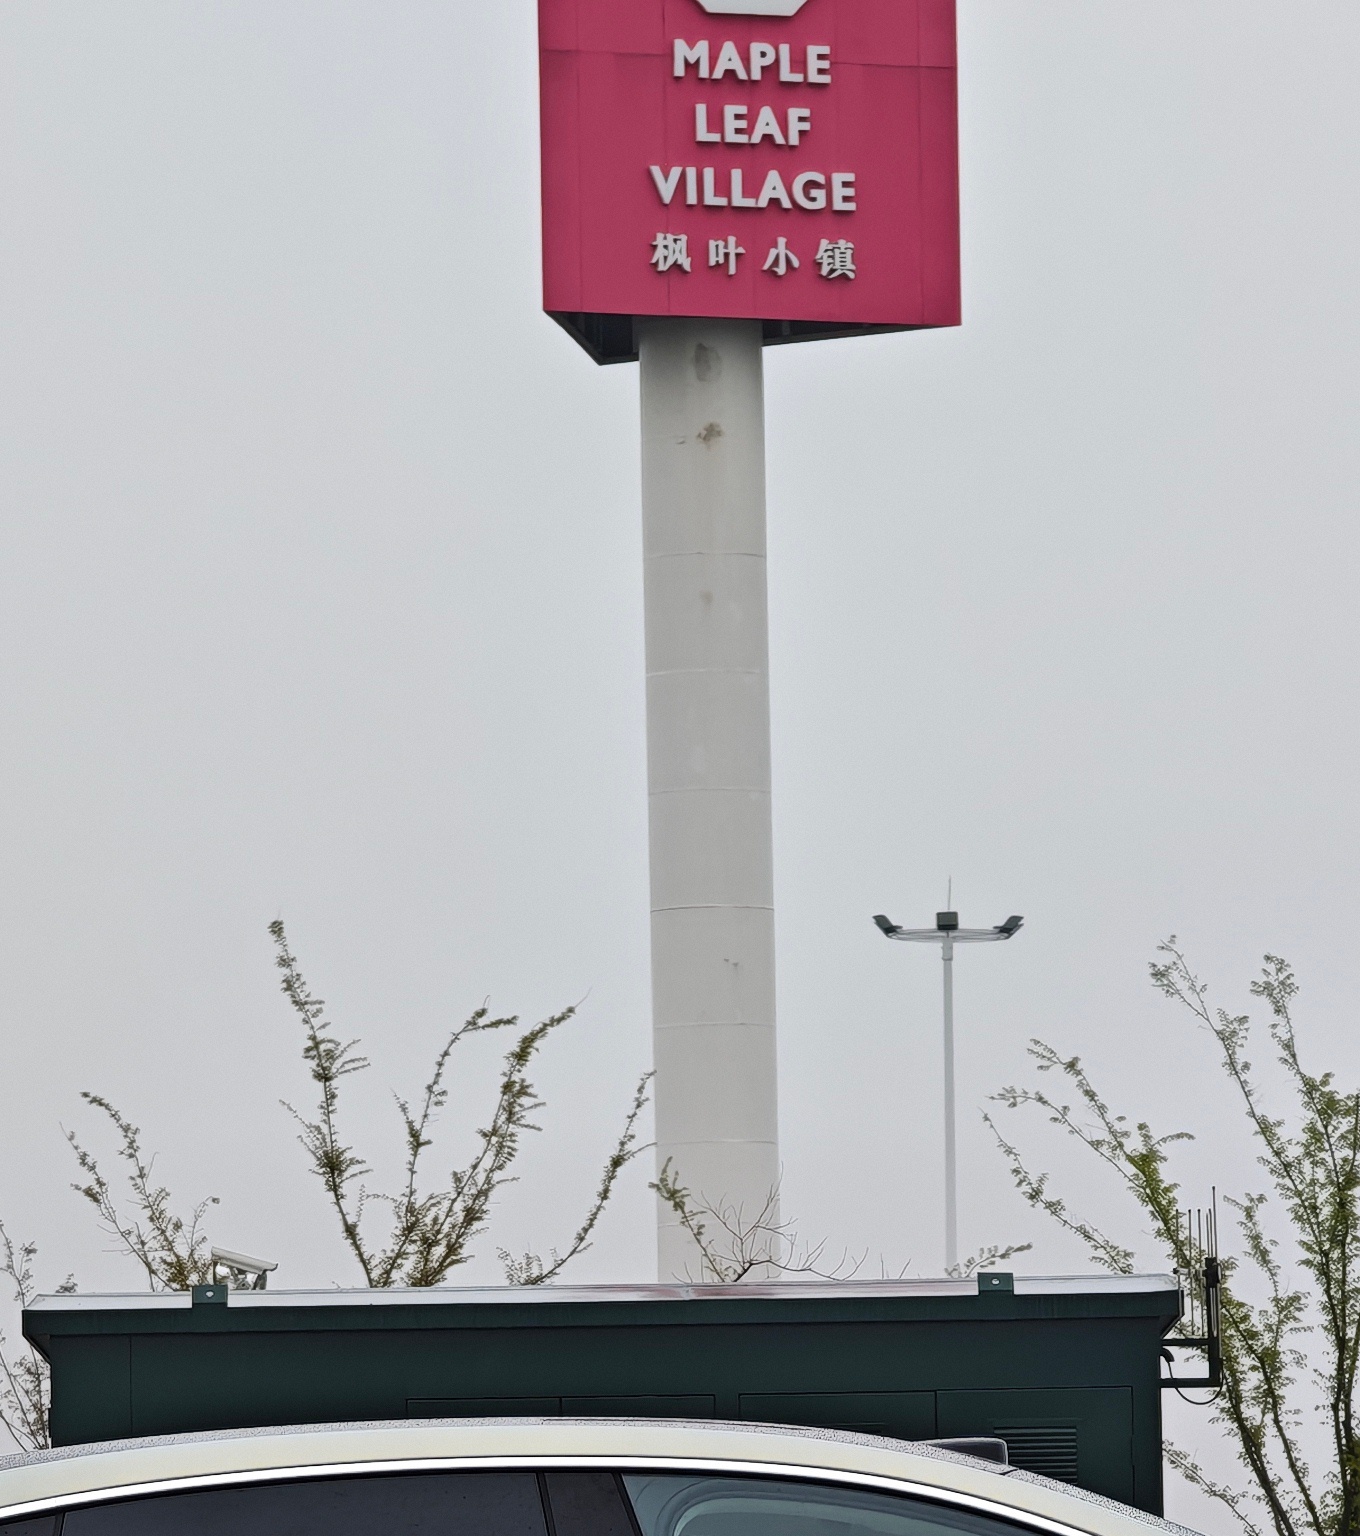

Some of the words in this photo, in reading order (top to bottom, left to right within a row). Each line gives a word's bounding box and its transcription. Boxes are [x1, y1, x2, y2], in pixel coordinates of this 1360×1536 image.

[673, 38, 831, 84] MAPLE
[696, 103, 811, 146] LEAF
[649, 165, 857, 212] VILLAGE
[650, 232, 857, 280] 枫叶小镇
